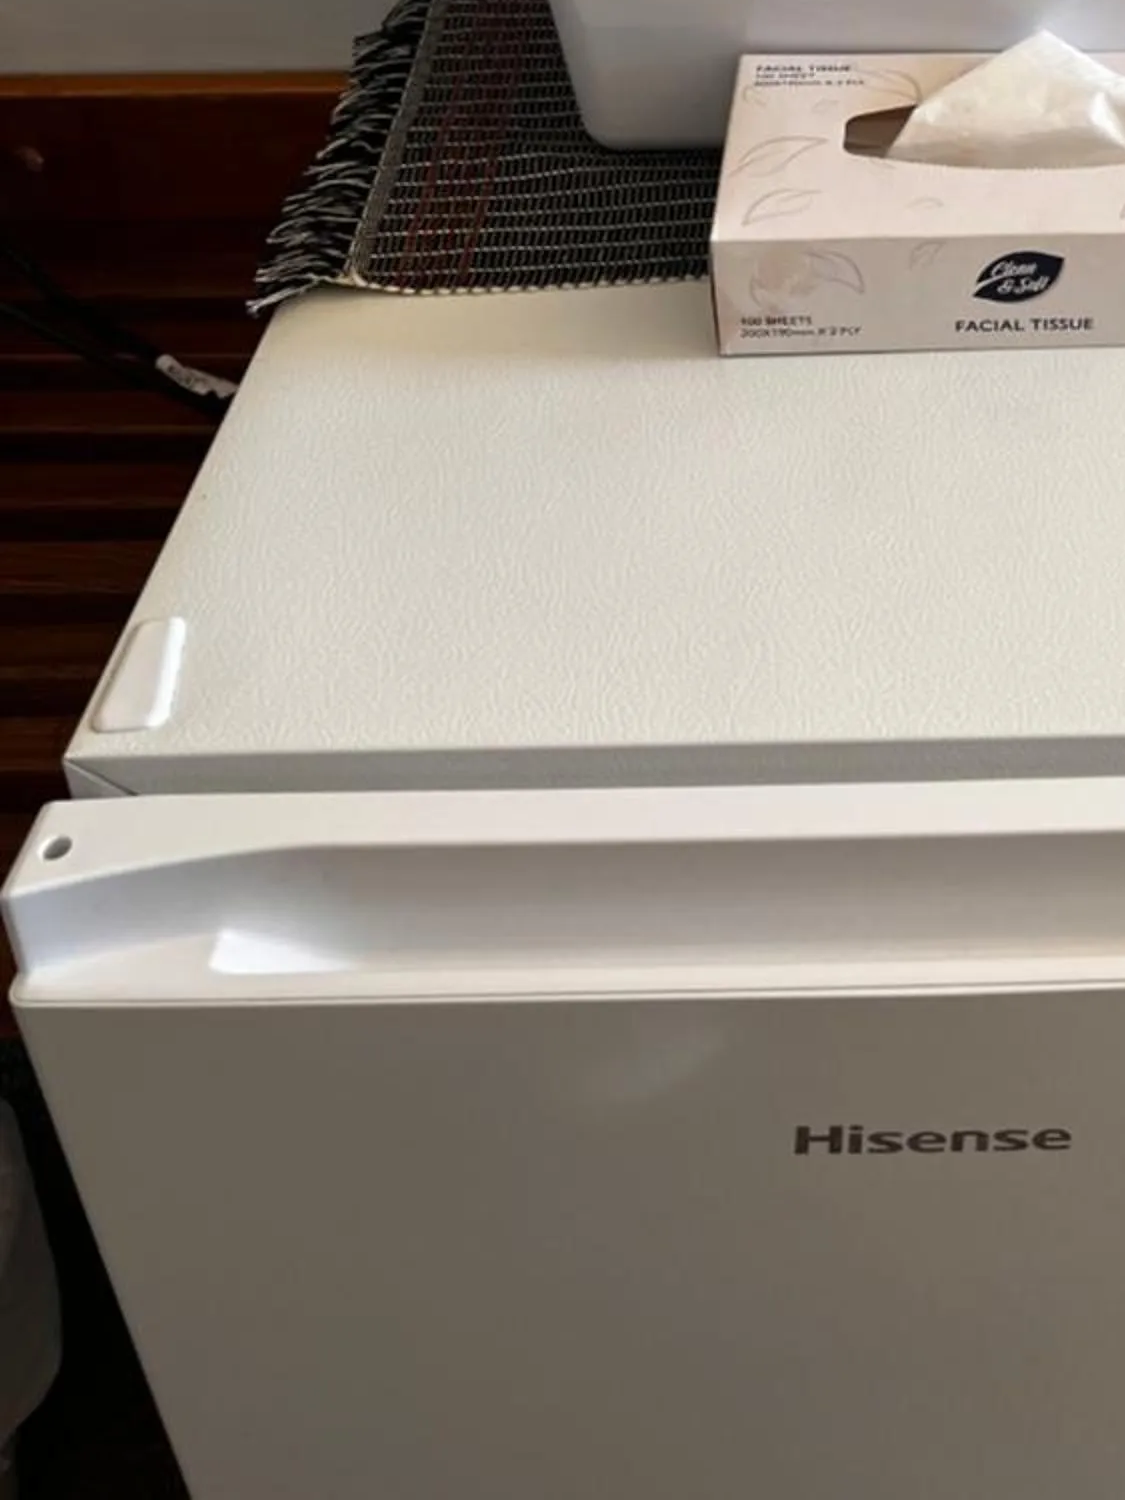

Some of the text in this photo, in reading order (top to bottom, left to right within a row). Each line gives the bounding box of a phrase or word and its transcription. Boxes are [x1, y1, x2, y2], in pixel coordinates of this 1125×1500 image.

[991, 260, 1038, 278] Clean
[1015, 275, 1050, 295] Soft
[955, 316, 1095, 333] FACIAL TISSUE
[794, 1124, 1072, 1155] Hisense
